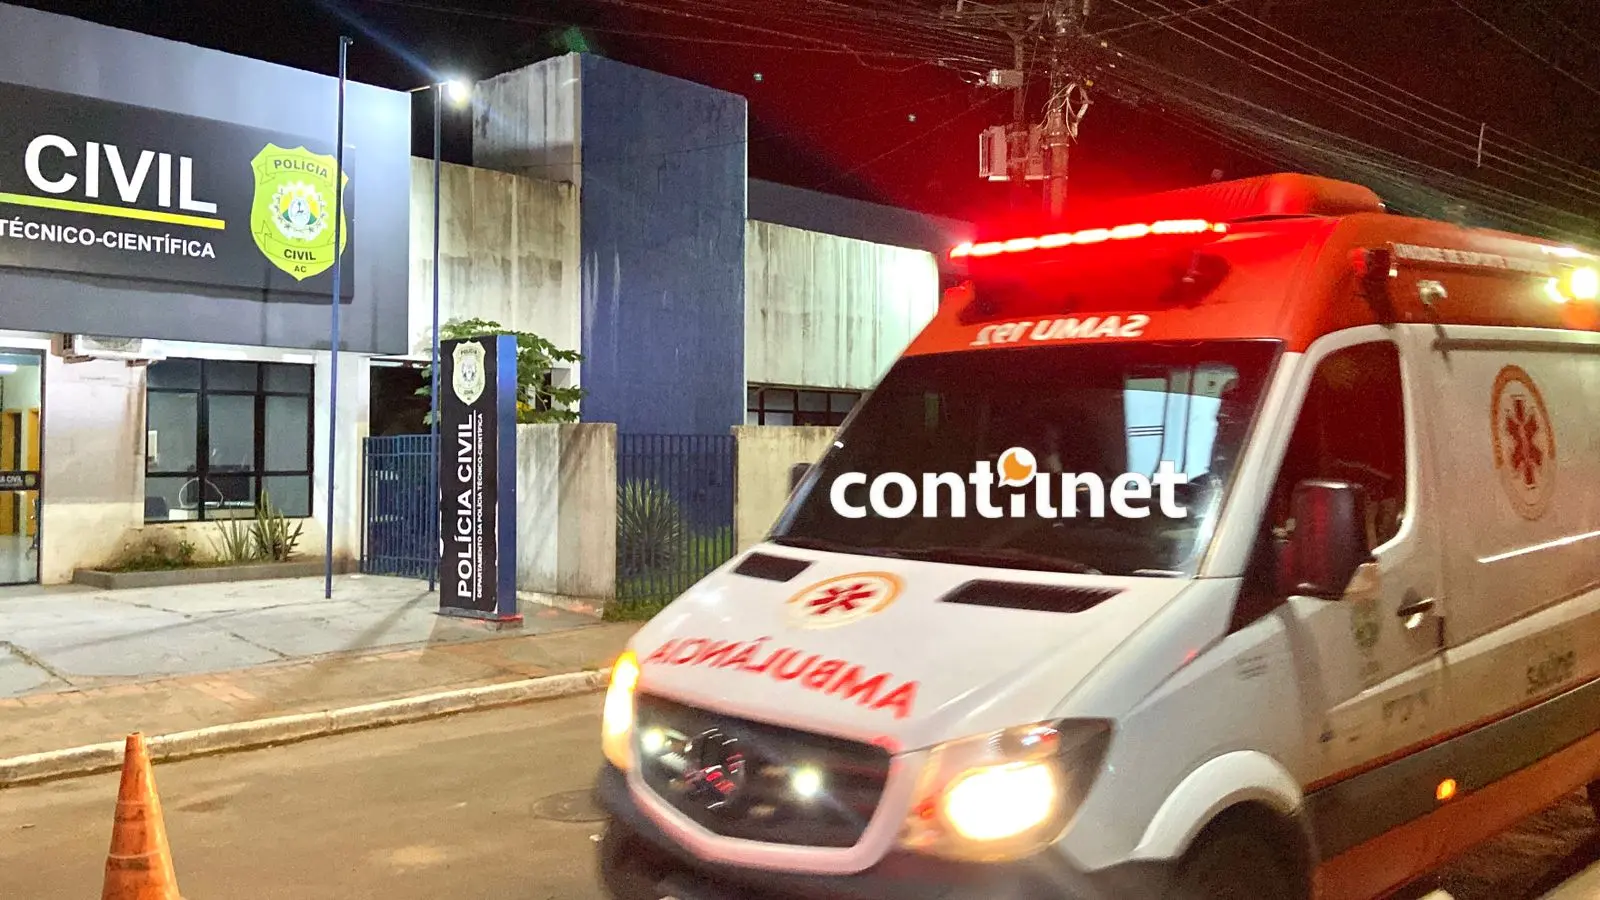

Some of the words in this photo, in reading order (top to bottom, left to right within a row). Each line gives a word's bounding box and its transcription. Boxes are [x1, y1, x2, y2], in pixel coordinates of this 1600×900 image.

[24, 134, 218, 214] CIVIL
[0, 216, 216, 259] TÉCNICO-CIENTÍFICA
[283, 249, 317, 261] CIVIL
[294, 265, 307, 273] AC
[457, 414, 473, 483] CIVIL
[454, 489, 472, 598] POLÍCIA
